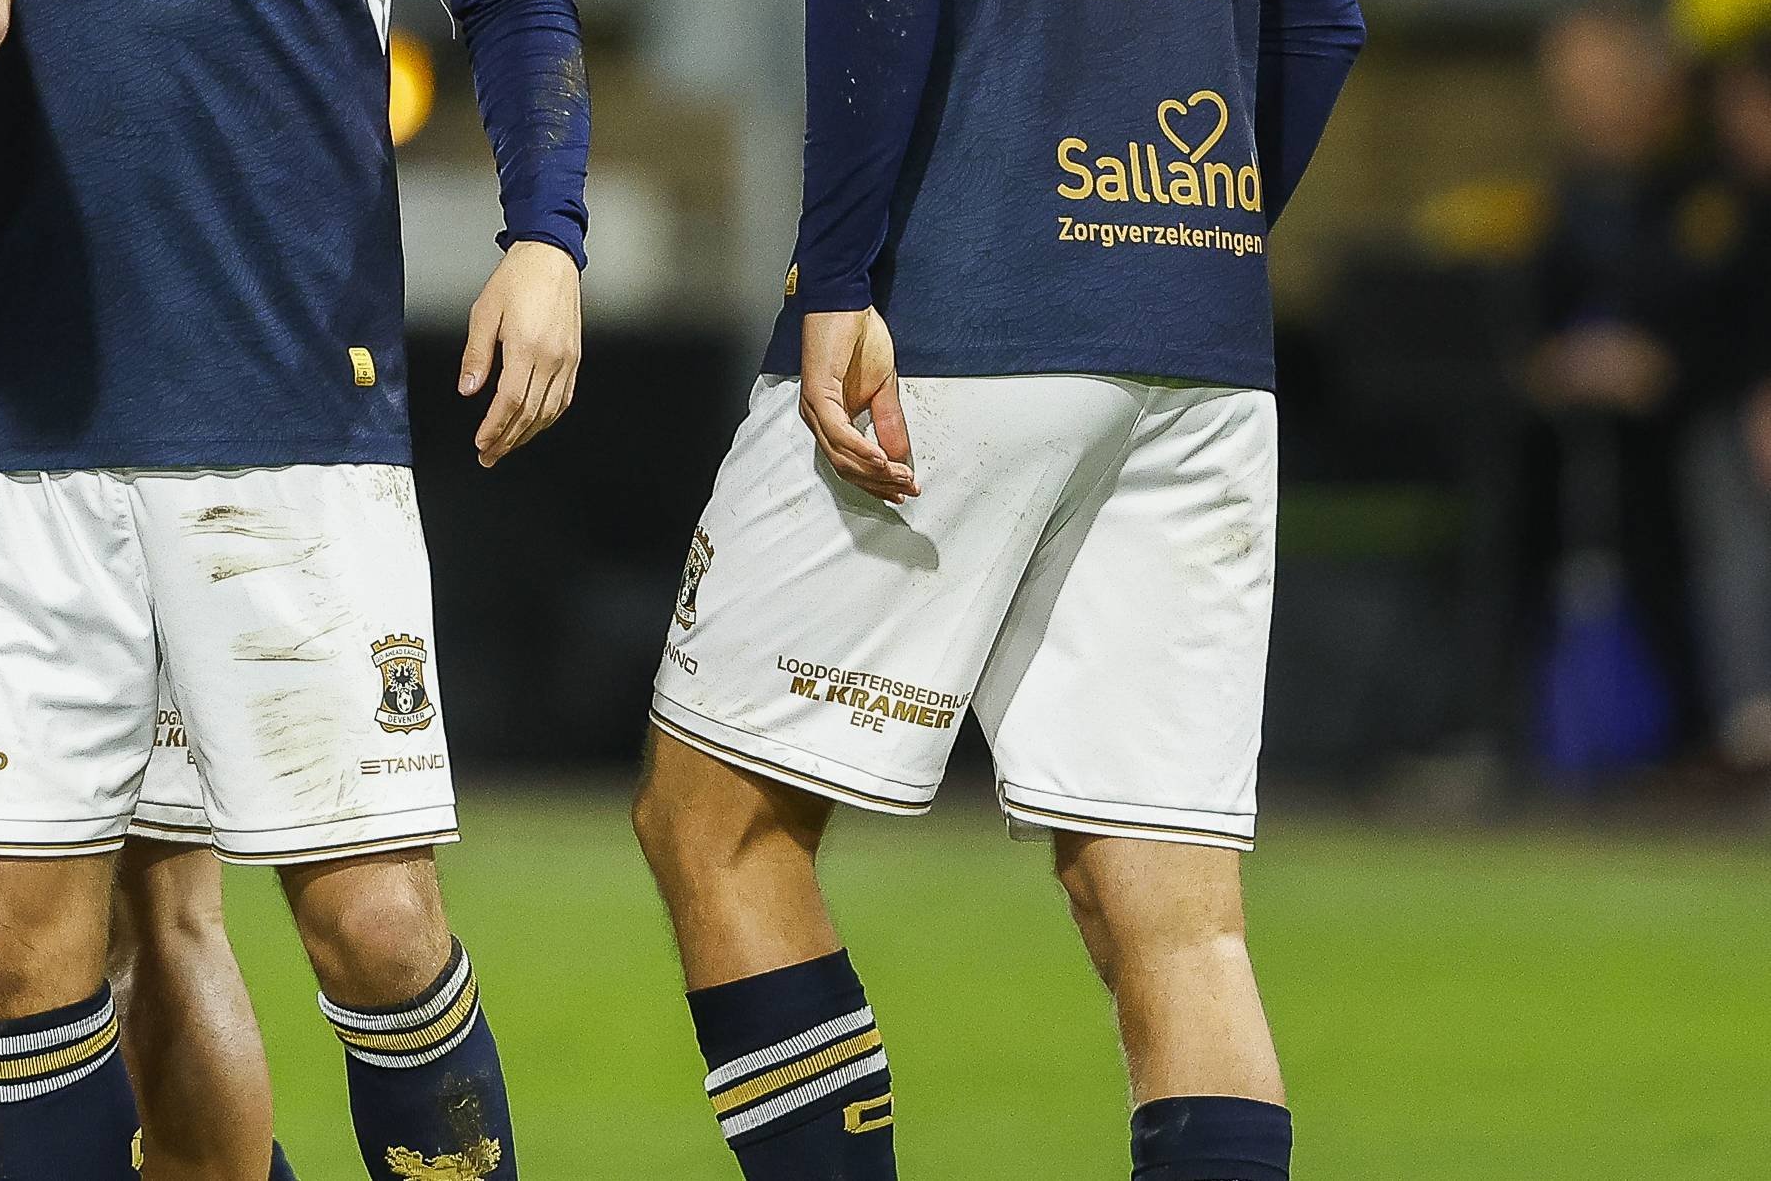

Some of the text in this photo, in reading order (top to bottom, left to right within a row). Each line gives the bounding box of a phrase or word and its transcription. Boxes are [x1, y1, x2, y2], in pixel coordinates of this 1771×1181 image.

[1057, 137, 1262, 212] Salland
[1058, 217, 1264, 257] Zorgverzekeringen
[777, 655, 972, 709] LOODGIETERSBEDRIJF
[789, 676, 956, 729] M. KRAMER
[387, 711, 426, 724] DEVENTER
[850, 711, 886, 733] EPE
